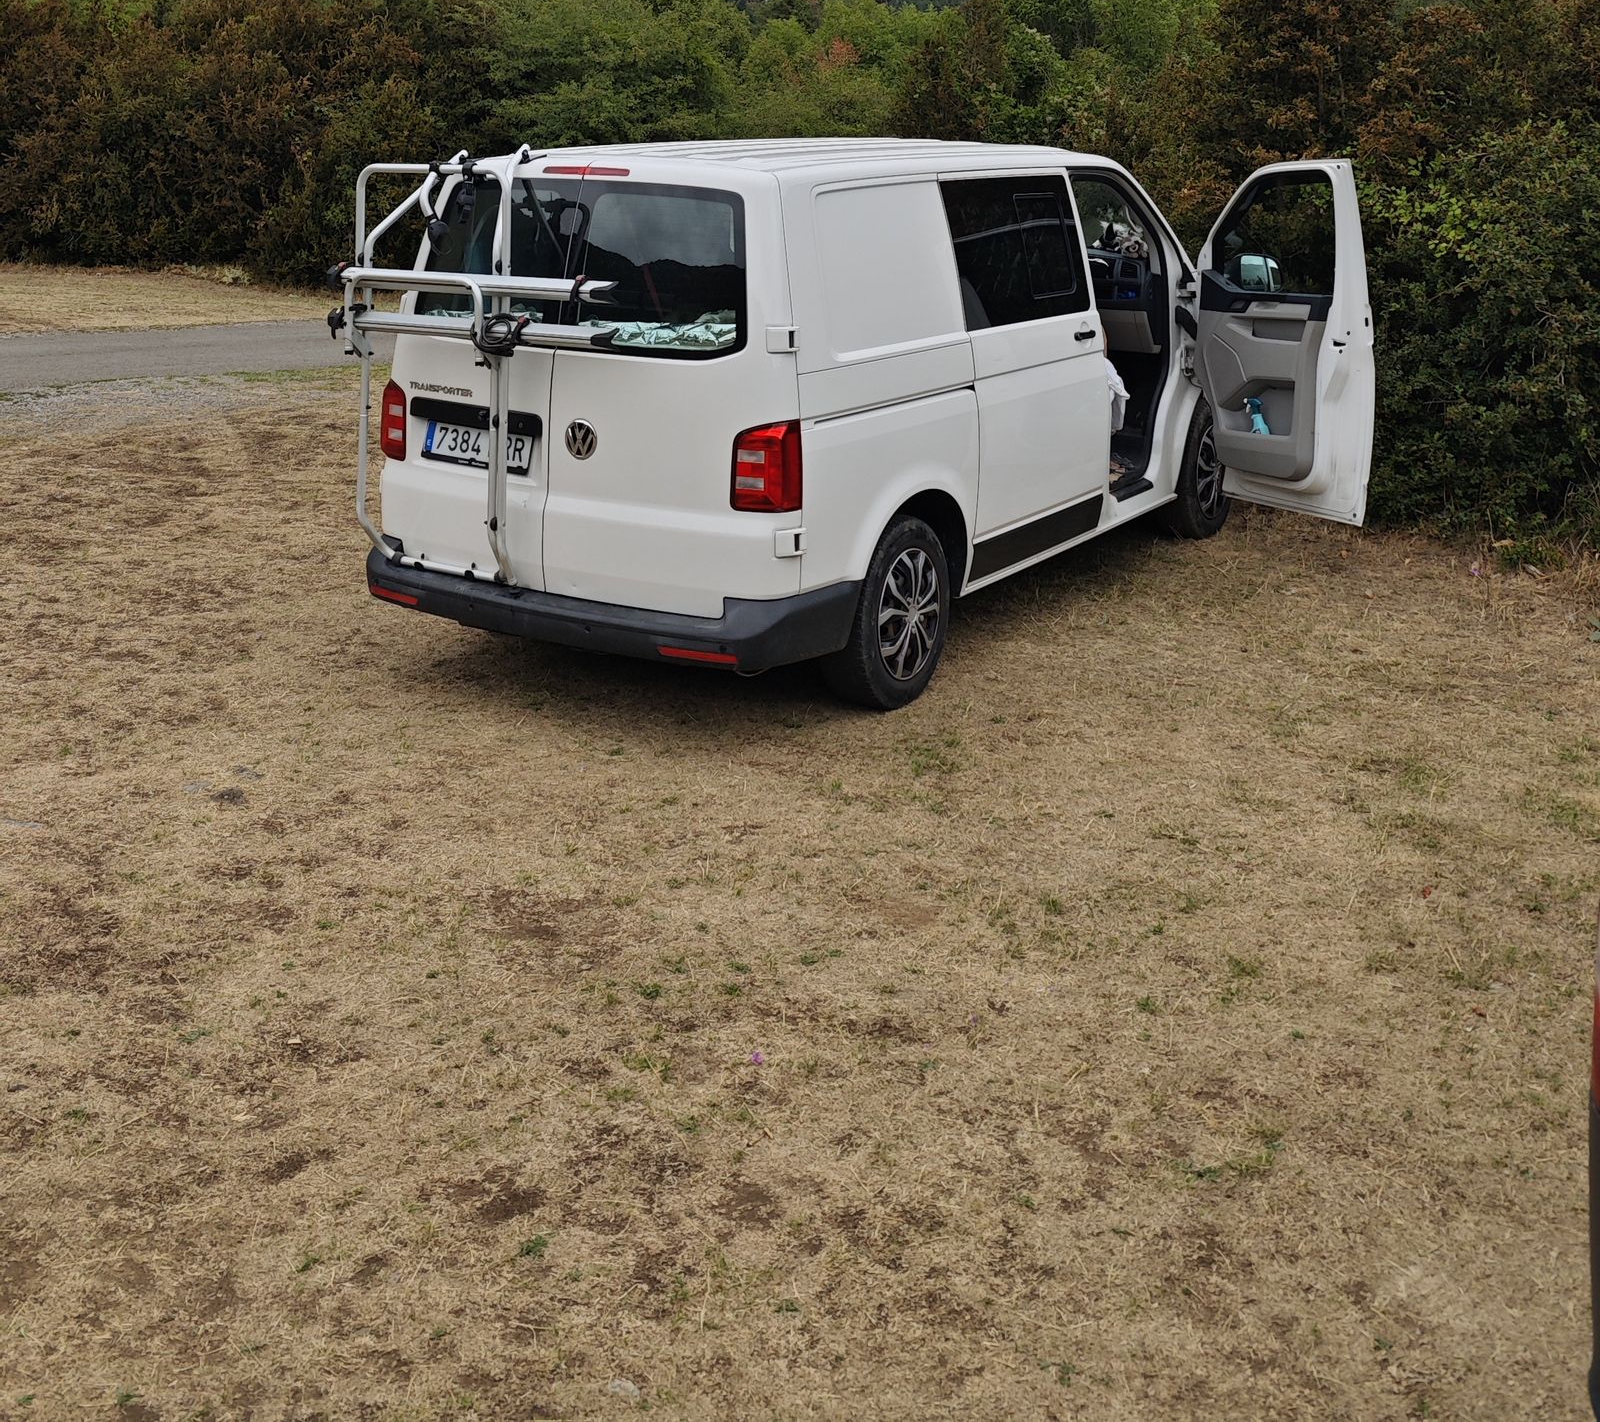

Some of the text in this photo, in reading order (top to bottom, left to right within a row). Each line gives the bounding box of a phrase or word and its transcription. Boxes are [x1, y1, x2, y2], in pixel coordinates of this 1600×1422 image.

[409, 381, 473, 398] TRANSPORTER
[437, 426, 482, 456] 7384
[567, 420, 596, 459] VW
